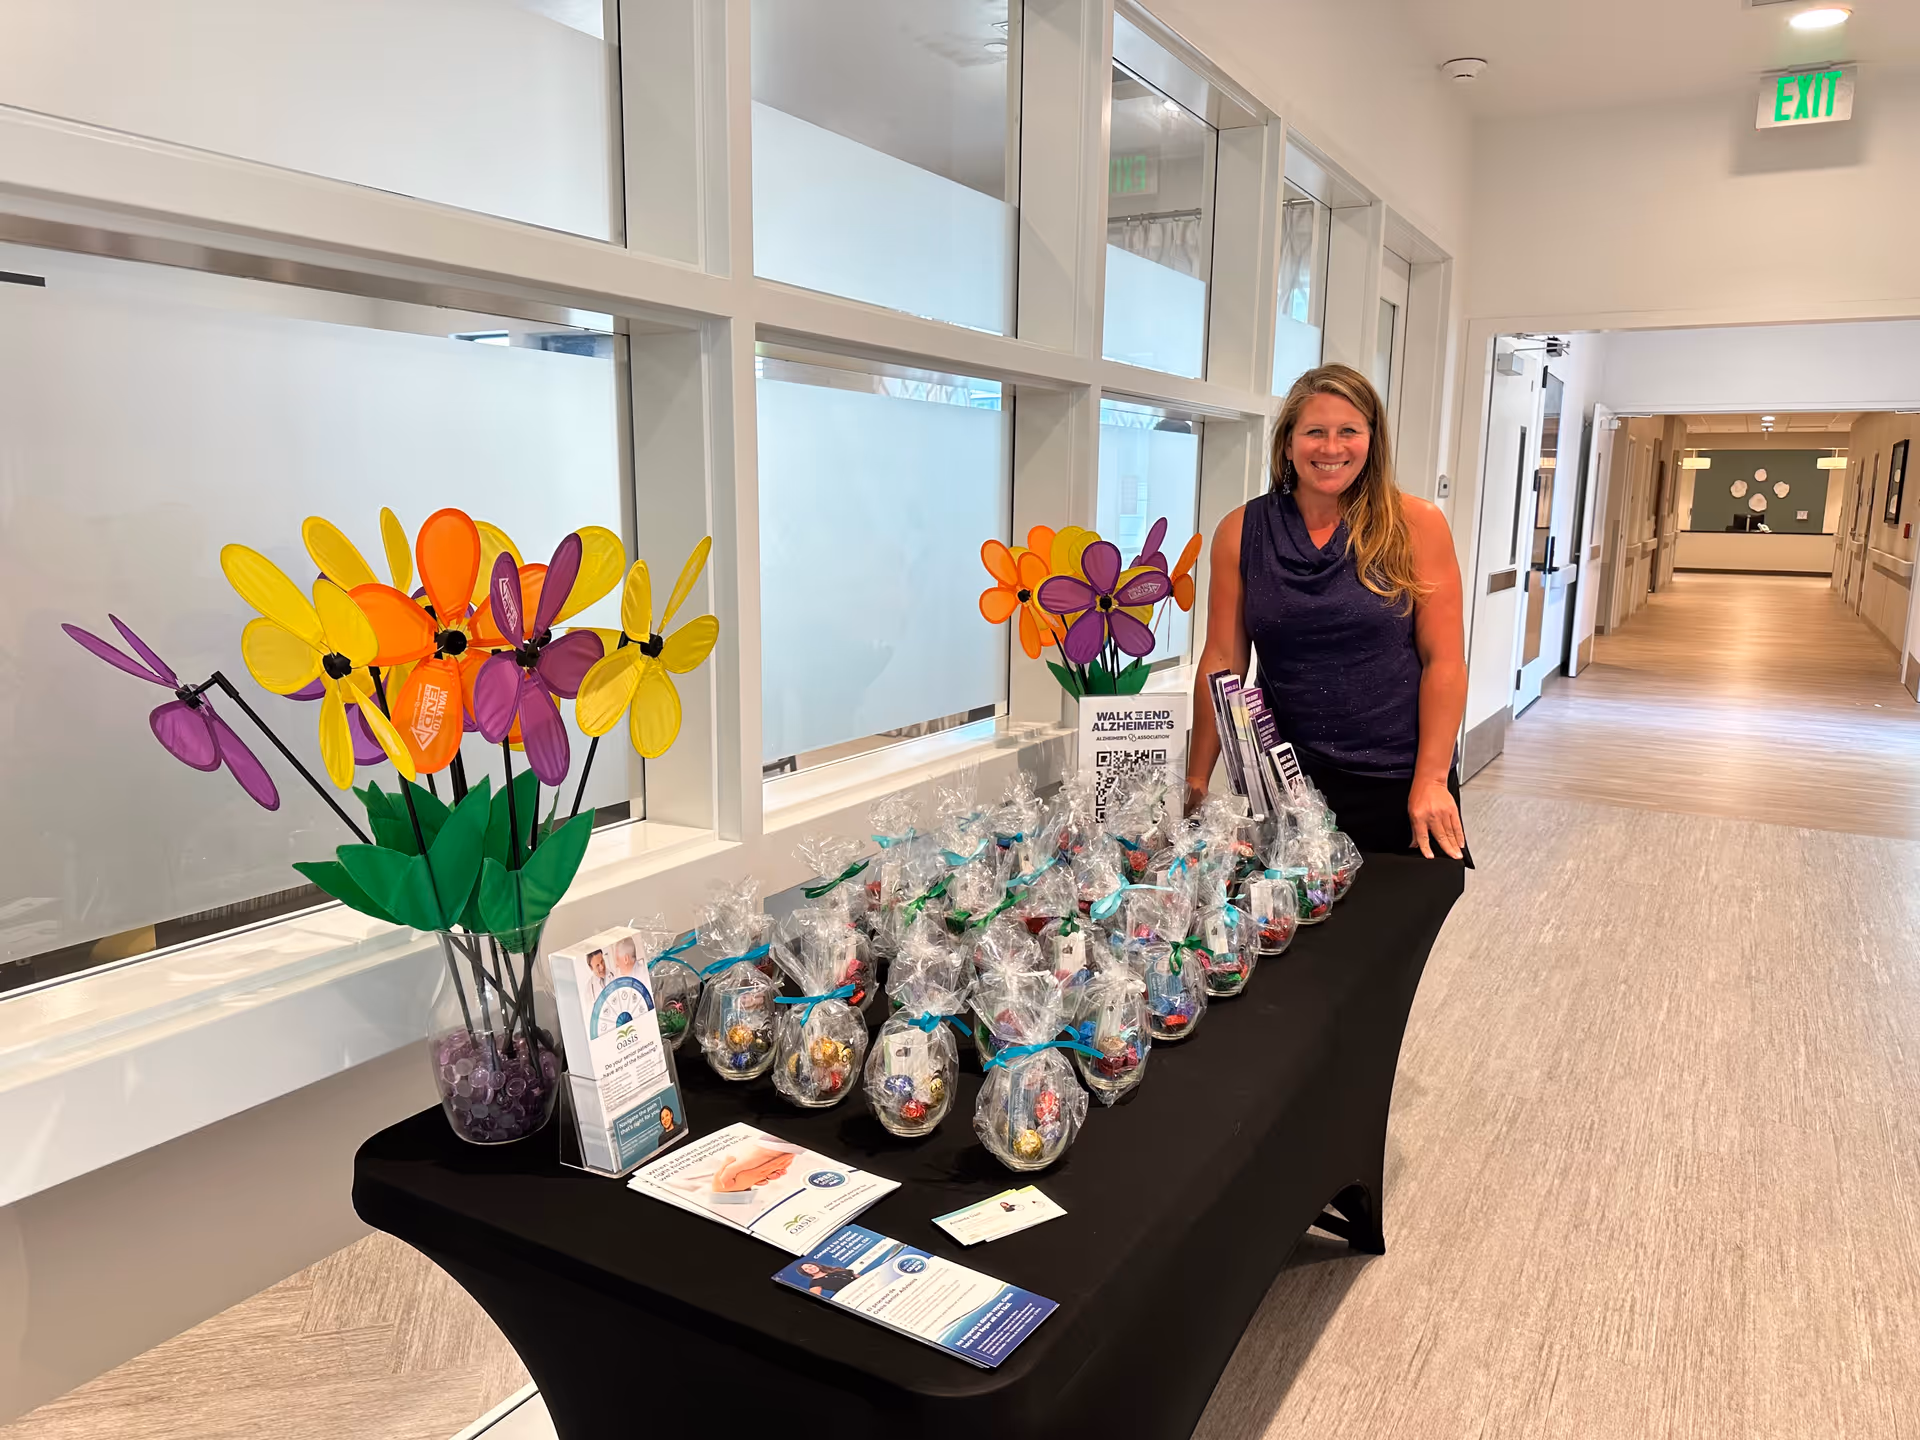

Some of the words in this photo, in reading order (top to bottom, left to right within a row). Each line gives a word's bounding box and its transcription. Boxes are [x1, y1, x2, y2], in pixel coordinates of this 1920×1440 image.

[1774, 71, 1842, 122] EXIT
[424, 687, 439, 728] END
[435, 690, 449, 717] WALK
[1096, 711, 1133, 721] WALK
[1144, 710, 1170, 720] END
[432, 718, 443, 730] TO
[1092, 720, 1174, 732] ALZHEIMER'S
[613, 1058, 623, 1068] your
[623, 1050, 637, 1059] senior
[637, 1041, 654, 1054] patients
[617, 1033, 638, 1050] oasis
[615, 1066, 623, 1074] any
[637, 1045, 658, 1059] following?
[619, 1115, 639, 1128] Navigate
[647, 1102, 657, 1112] path
[620, 1124, 633, 1135] that's
[646, 1164, 669, 1176] When
[674, 1148, 698, 1162] patient
[699, 1137, 719, 1149] needs
[653, 1166, 670, 1179] right
[671, 1157, 690, 1169] home
[690, 1141, 723, 1159] transition
[660, 1170, 679, 1181] we're
[679, 1163, 691, 1171] the
[691, 1154, 707, 1165] right
[708, 1144, 731, 1156] people
[790, 1216, 816, 1234] oasis
[832, 1247, 847, 1258] Senior
[846, 1235, 864, 1248] Advisors
[873, 1304, 887, 1315] Oasis
[886, 1292, 900, 1305] Senior
[899, 1278, 918, 1293] Advisors
